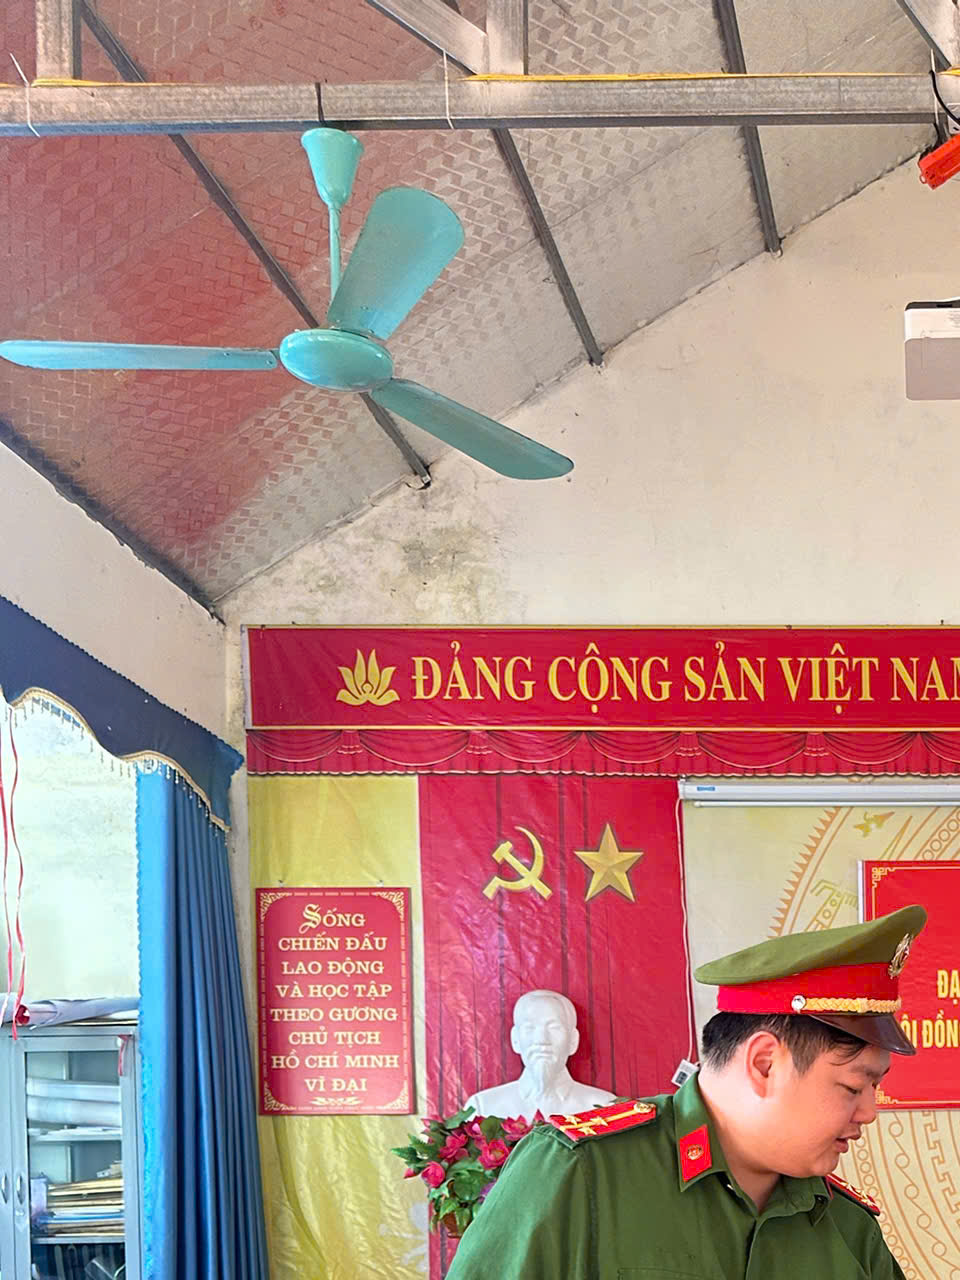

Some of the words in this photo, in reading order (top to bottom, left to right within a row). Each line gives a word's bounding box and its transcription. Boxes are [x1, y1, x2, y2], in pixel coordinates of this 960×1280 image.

[411, 641, 536, 702] ĐẢNG
[549, 642, 672, 714] CỘNG
[685, 641, 766, 702] SẢN
[777, 643, 880, 715] VIỆT
[299, 904, 366, 934] SỐNG
[278, 932, 340, 951] CHIẾN
[345, 932, 388, 951] ĐẤU
[282, 961, 322, 976] LAO
[328, 957, 385, 978] ĐỘNG
[276, 982, 302, 999] VÀ
[309, 984, 349, 1001] HỌC
[354, 981, 393, 1001] TẬP
[271, 1008, 324, 1022] THEO
[329, 1007, 399, 1022] GƯƠNG
[289, 1026, 329, 1046] CHỦ
[334, 1031, 382, 1049] TỊCH
[272, 1049, 300, 1070] HỒ
[305, 1050, 340, 1069] CHÍ
[346, 1055, 400, 1069] MINH
[305, 1078, 326, 1093] VĨ
[332, 1078, 368, 1095] ĐẠI
